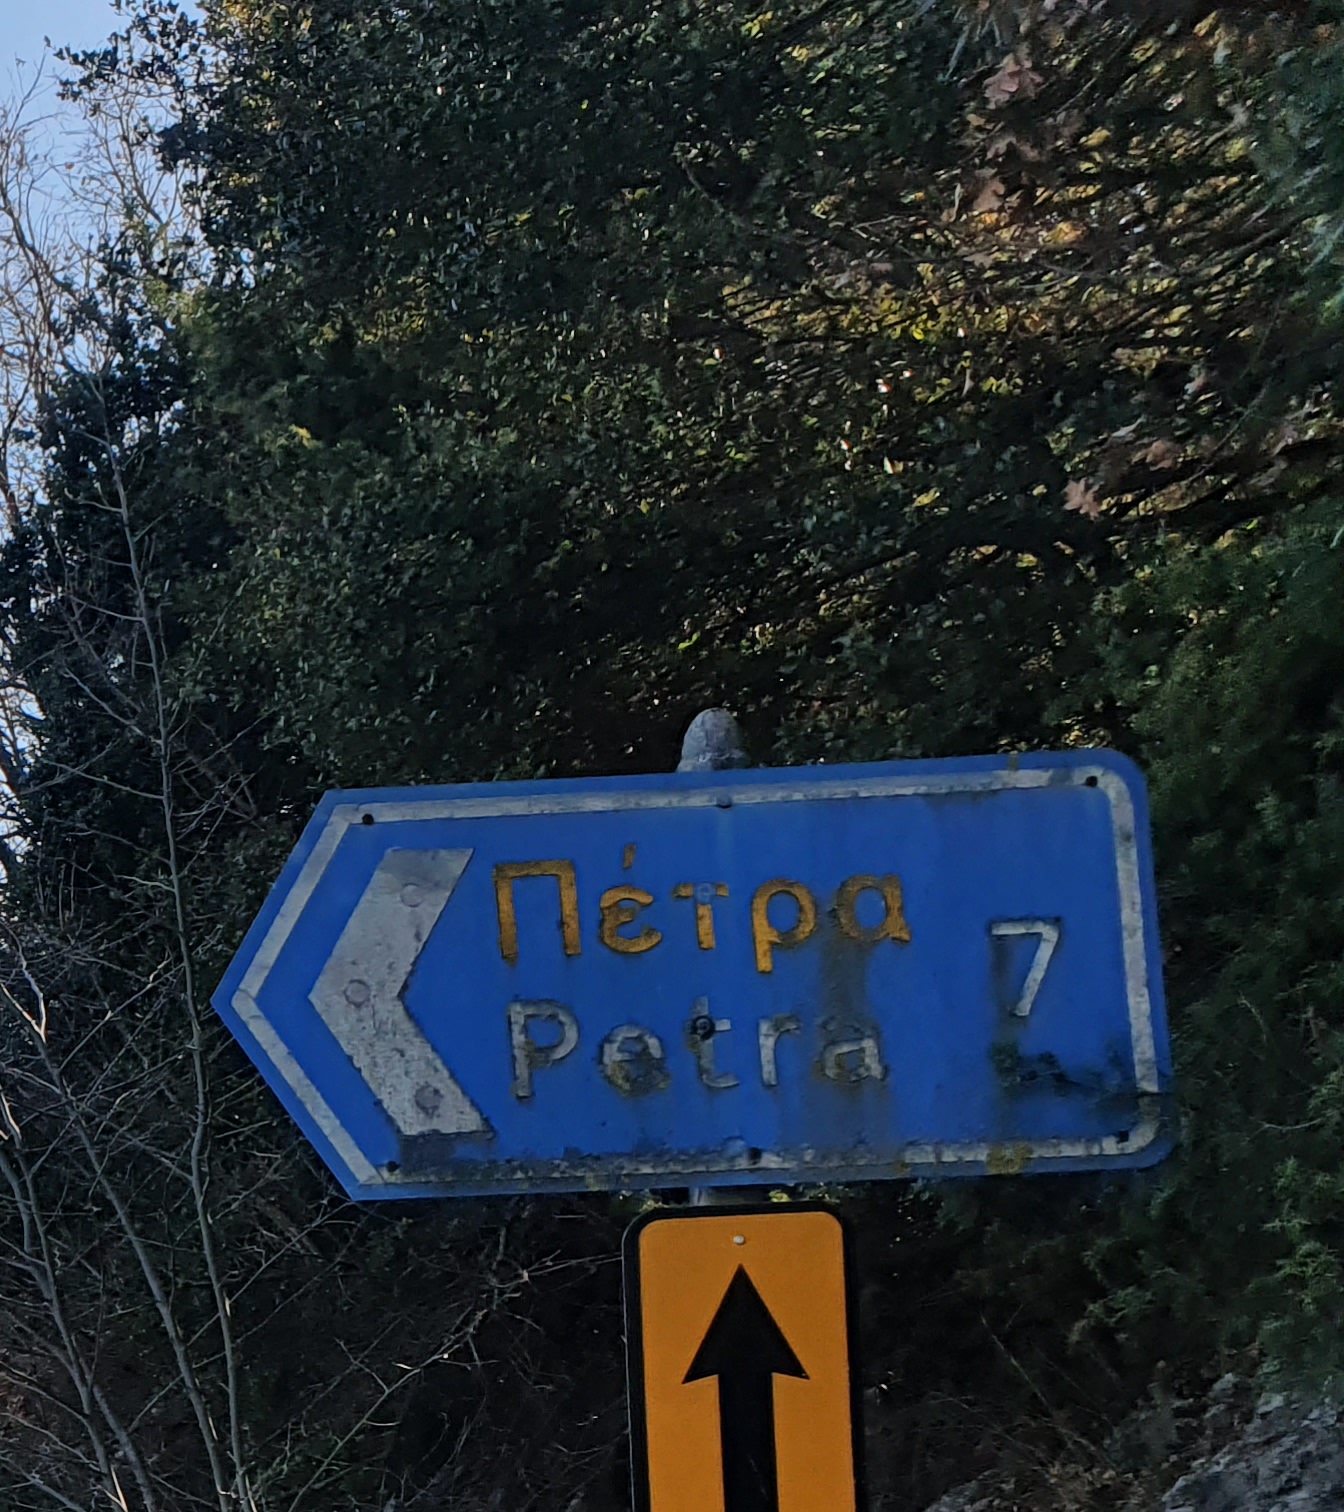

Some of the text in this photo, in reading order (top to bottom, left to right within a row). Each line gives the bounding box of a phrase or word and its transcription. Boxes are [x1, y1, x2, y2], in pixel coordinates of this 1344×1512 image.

[493, 843, 910, 974] Πέτρα
[991, 920, 1060, 1016] 7
[507, 996, 889, 1099] Petra
